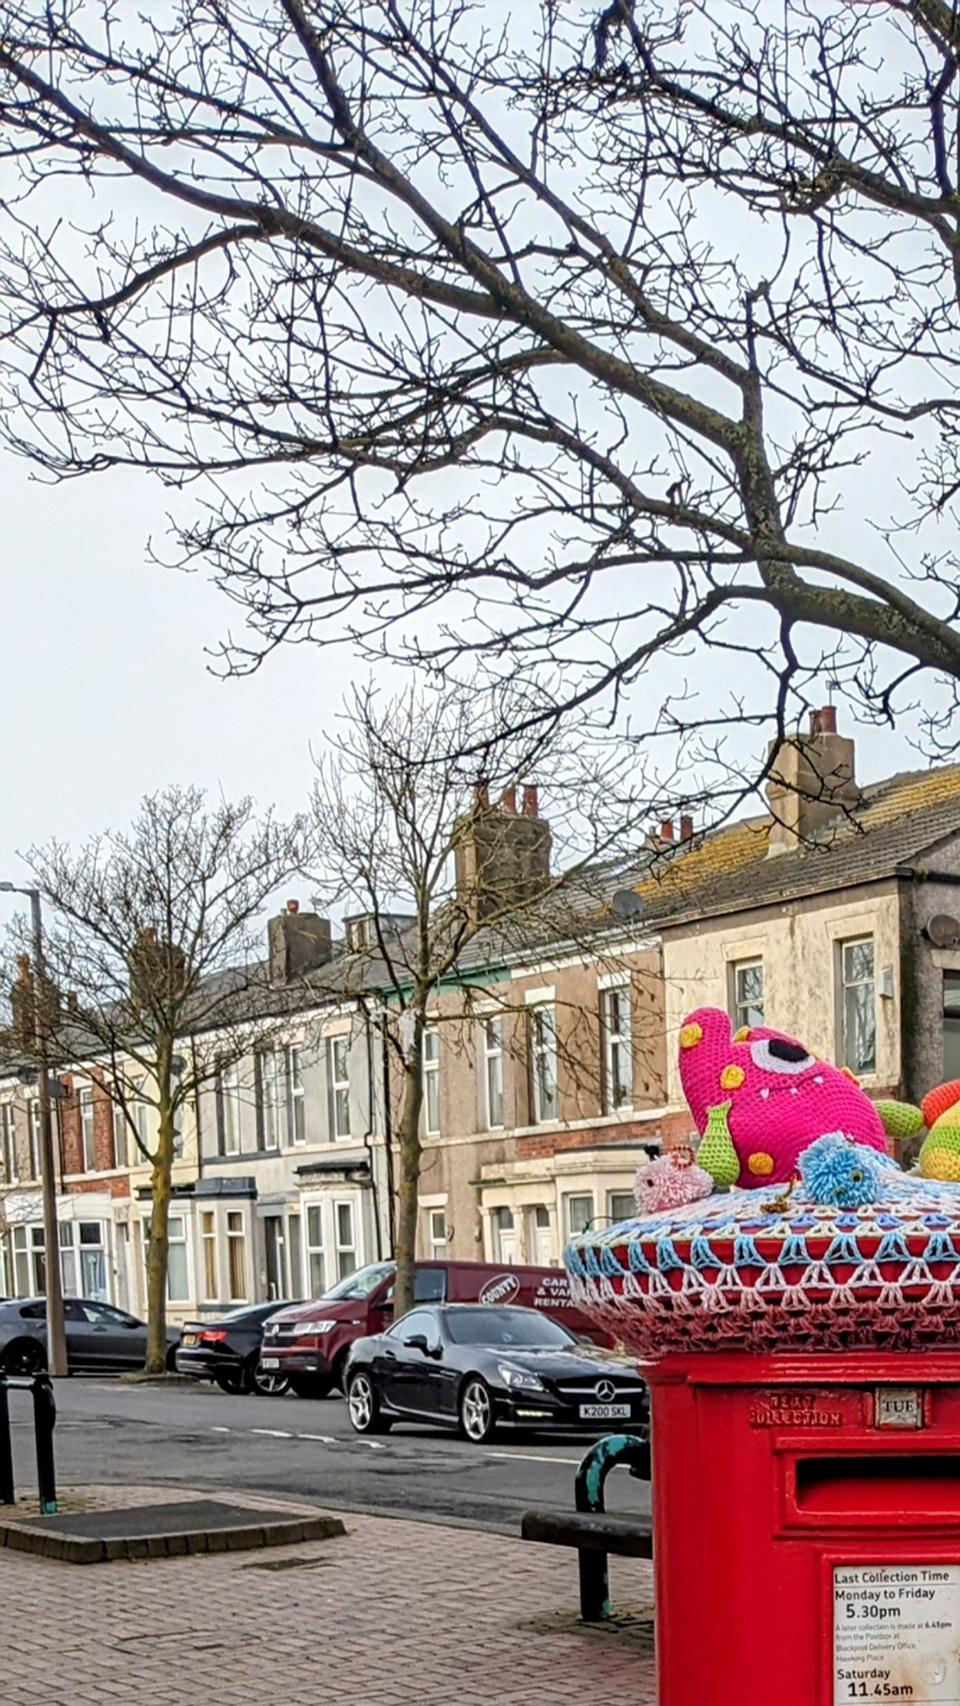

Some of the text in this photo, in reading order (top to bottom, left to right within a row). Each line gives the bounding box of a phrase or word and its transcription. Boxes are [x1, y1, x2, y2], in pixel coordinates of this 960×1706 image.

[543, 1278, 568, 1287] CAR
[481, 1276, 517, 1305] COUNTY
[534, 1298, 576, 1308] RENTA
[584, 1407, 628, 1417] K200 SKL
[883, 1400, 915, 1413] TUE
[749, 1409, 841, 1426] COLLECTION
[835, 1570, 950, 1584] Last Collection Time
[835, 1588, 936, 1603] Monday to Friday
[846, 1603, 901, 1620] 5.30pm
[858, 1623, 890, 1631] collection
[900, 1622, 916, 1630] made
[917, 1622, 925, 1630] at
[925, 1621, 952, 1631] 6.45pm
[865, 1632, 892, 1640] Postbox
[836, 1644, 868, 1653] Blackpool
[869, 1642, 896, 1651] Delivery
[837, 1668, 891, 1680] Saturday
[848, 1682, 914, 1697] 11.45am
